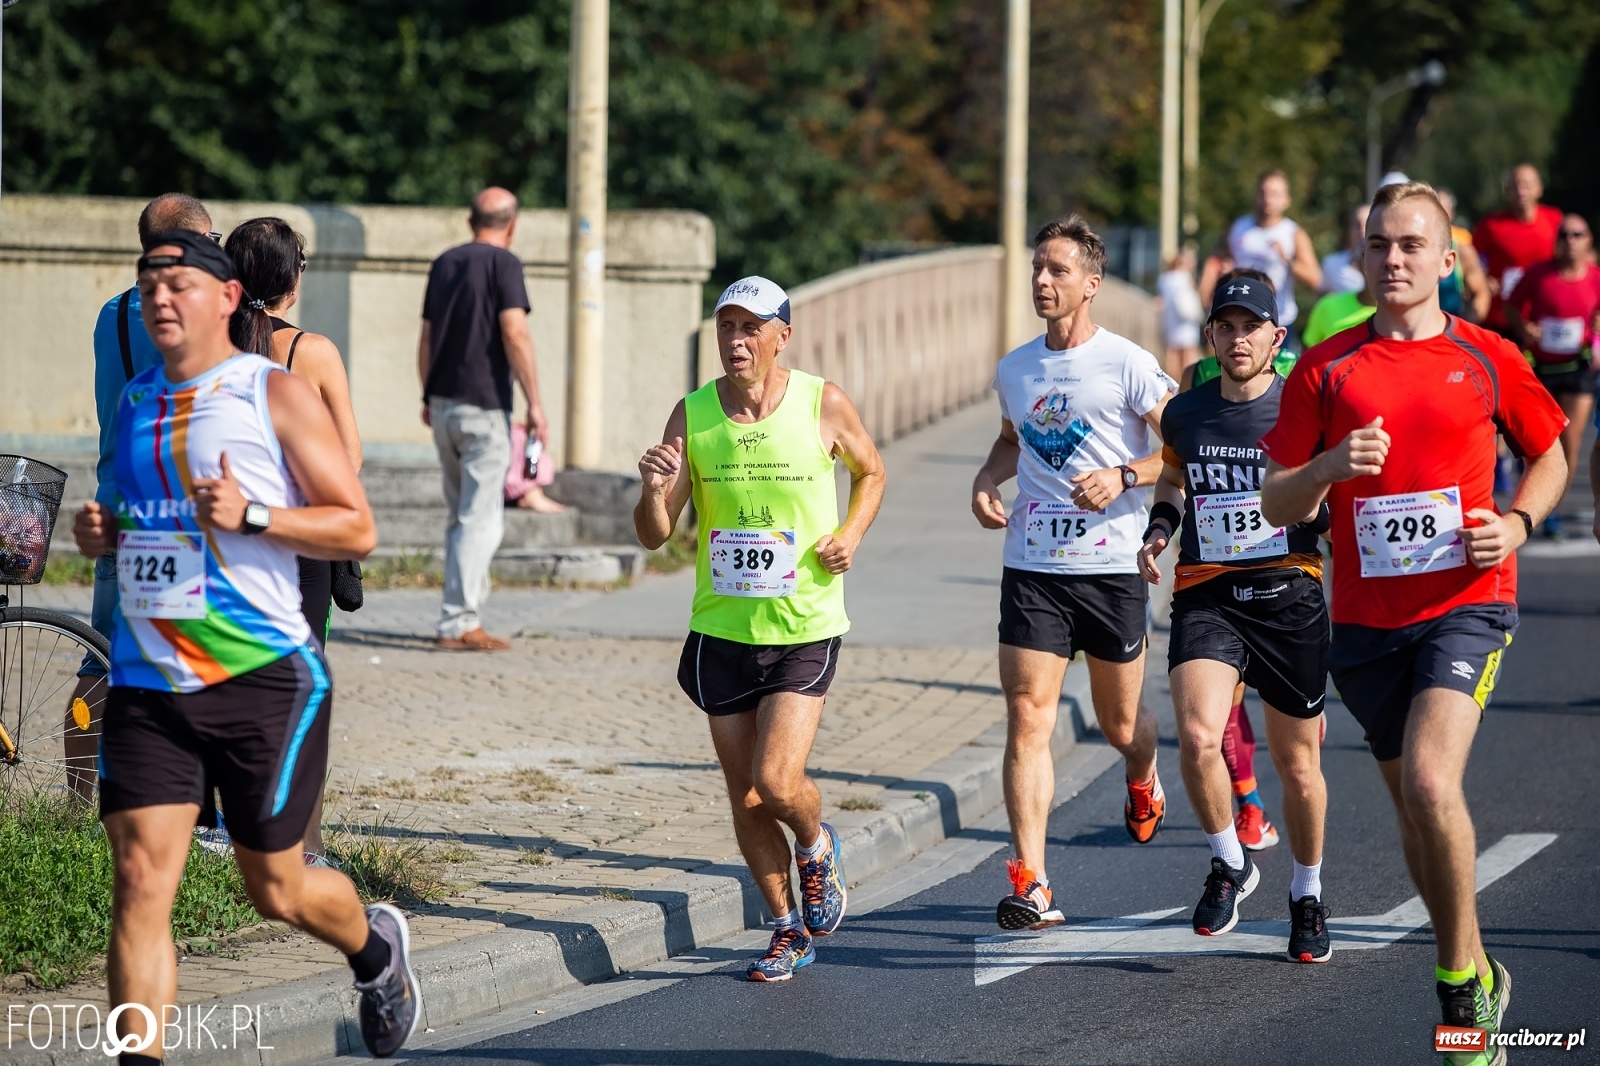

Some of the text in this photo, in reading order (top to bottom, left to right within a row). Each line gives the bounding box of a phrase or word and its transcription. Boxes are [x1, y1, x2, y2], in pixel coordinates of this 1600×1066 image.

[1199, 445, 1263, 460] LIVECHAT
[1050, 518, 1087, 538] 175
[1222, 509, 1262, 534] 133
[1384, 514, 1437, 543] 298
[133, 554, 177, 583] 224
[733, 548, 774, 571] 389
[1233, 585, 1254, 602] UE
